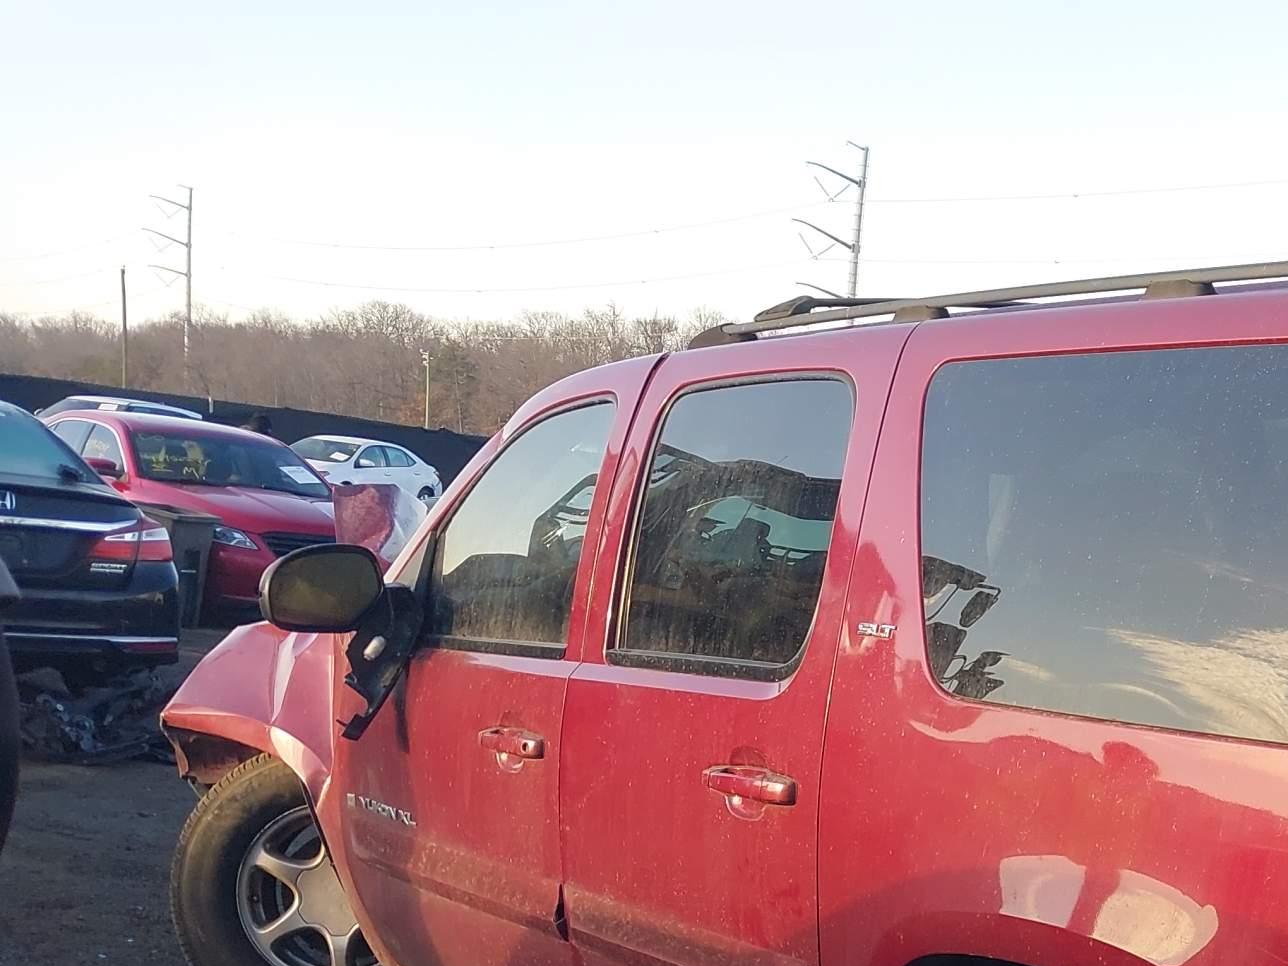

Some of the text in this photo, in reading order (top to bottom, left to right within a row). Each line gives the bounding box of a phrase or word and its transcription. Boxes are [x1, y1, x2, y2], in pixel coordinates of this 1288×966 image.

[857, 622, 898, 639] SLT
[358, 795, 397, 821] YUKON
[398, 809, 417, 828] XL
